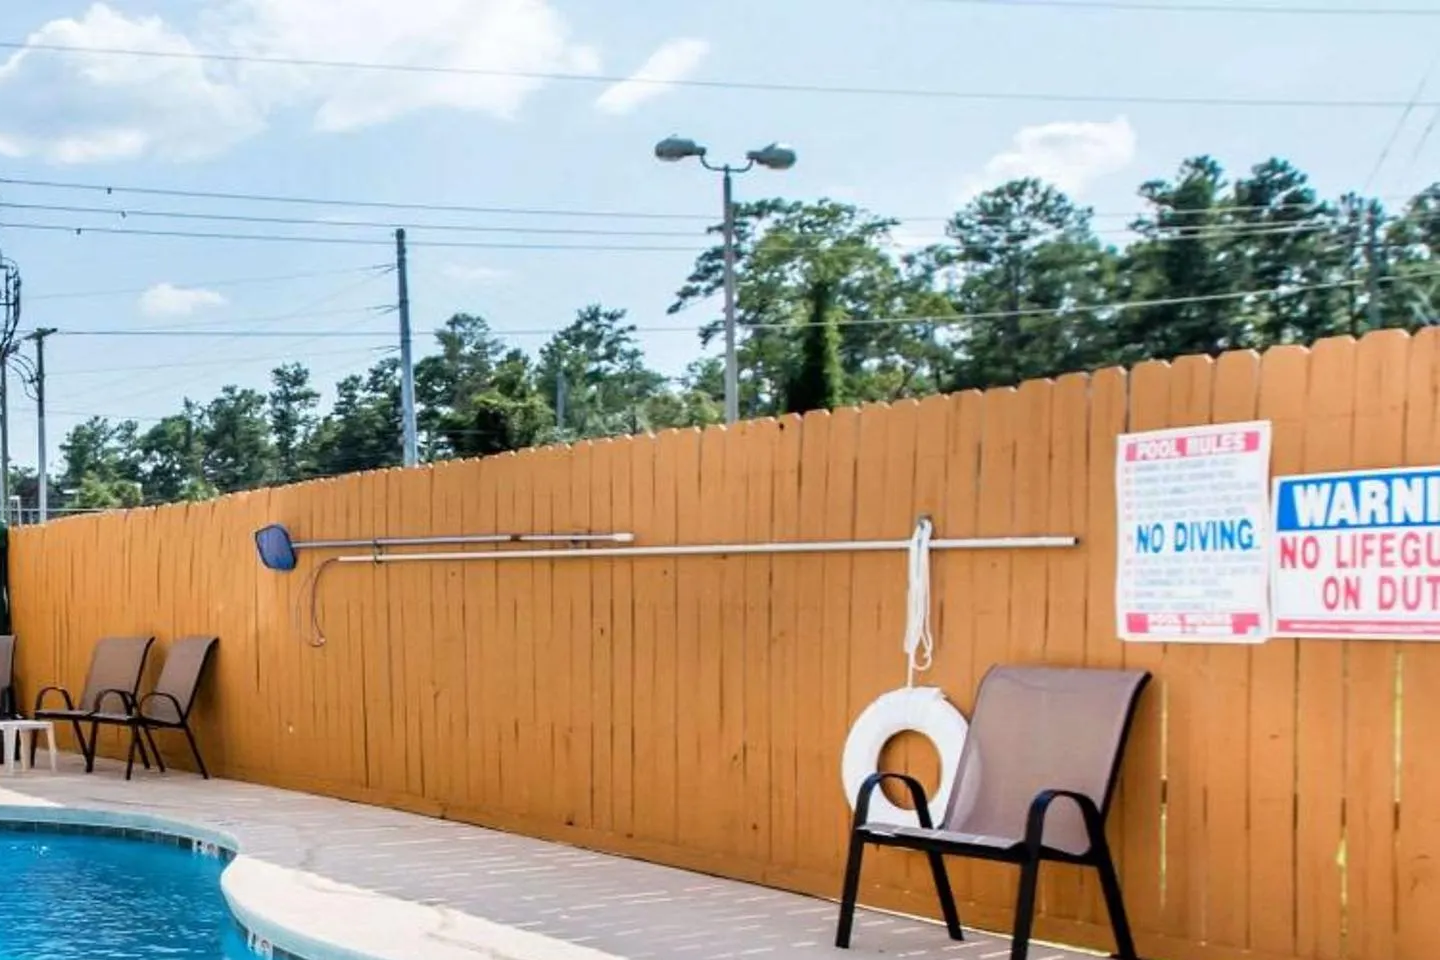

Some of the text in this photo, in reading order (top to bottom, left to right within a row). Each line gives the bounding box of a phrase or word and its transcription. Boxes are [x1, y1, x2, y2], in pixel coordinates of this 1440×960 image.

[1136, 439, 1180, 459] POOL
[1292, 477, 1440, 527] WARNI
[1135, 518, 1255, 553] NO DIVING
[1279, 536, 1321, 570] NO
[1322, 576, 1361, 611] ON
